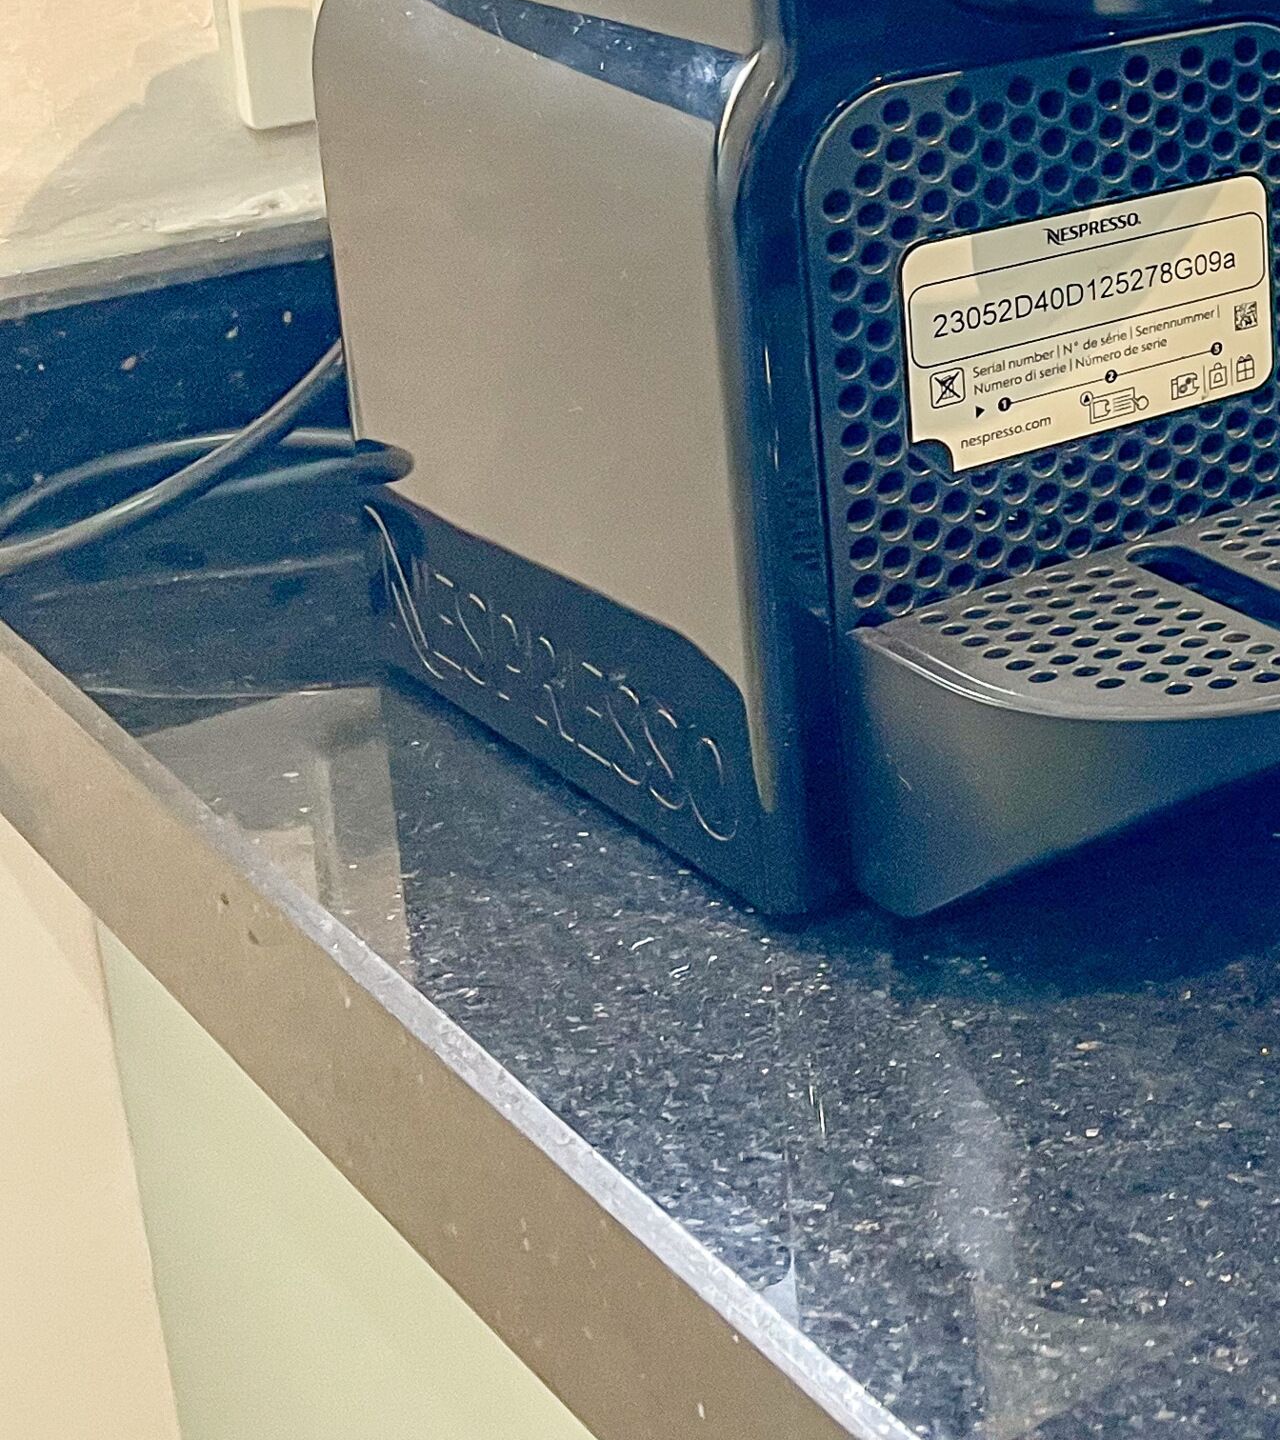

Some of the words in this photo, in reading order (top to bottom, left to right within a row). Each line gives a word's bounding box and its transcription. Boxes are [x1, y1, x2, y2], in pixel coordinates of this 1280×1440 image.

[1043, 212, 1141, 245] NESPRESSO
[933, 251, 1236, 338] 23052D40D125278G09a
[972, 359, 1006, 379] Serial
[1008, 349, 1054, 368] number
[1082, 338, 1098, 351] de
[1100, 330, 1128, 347] série
[1135, 308, 1215, 338] Seriennummer
[973, 376, 1022, 396] Numero
[1025, 369, 1037, 383] di
[1039, 363, 1067, 379] serie
[1075, 348, 1122, 370] Número
[1124, 342, 1139, 357] de
[1140, 337, 1168, 353] serie
[960, 416, 1052, 449] nespresso.com
